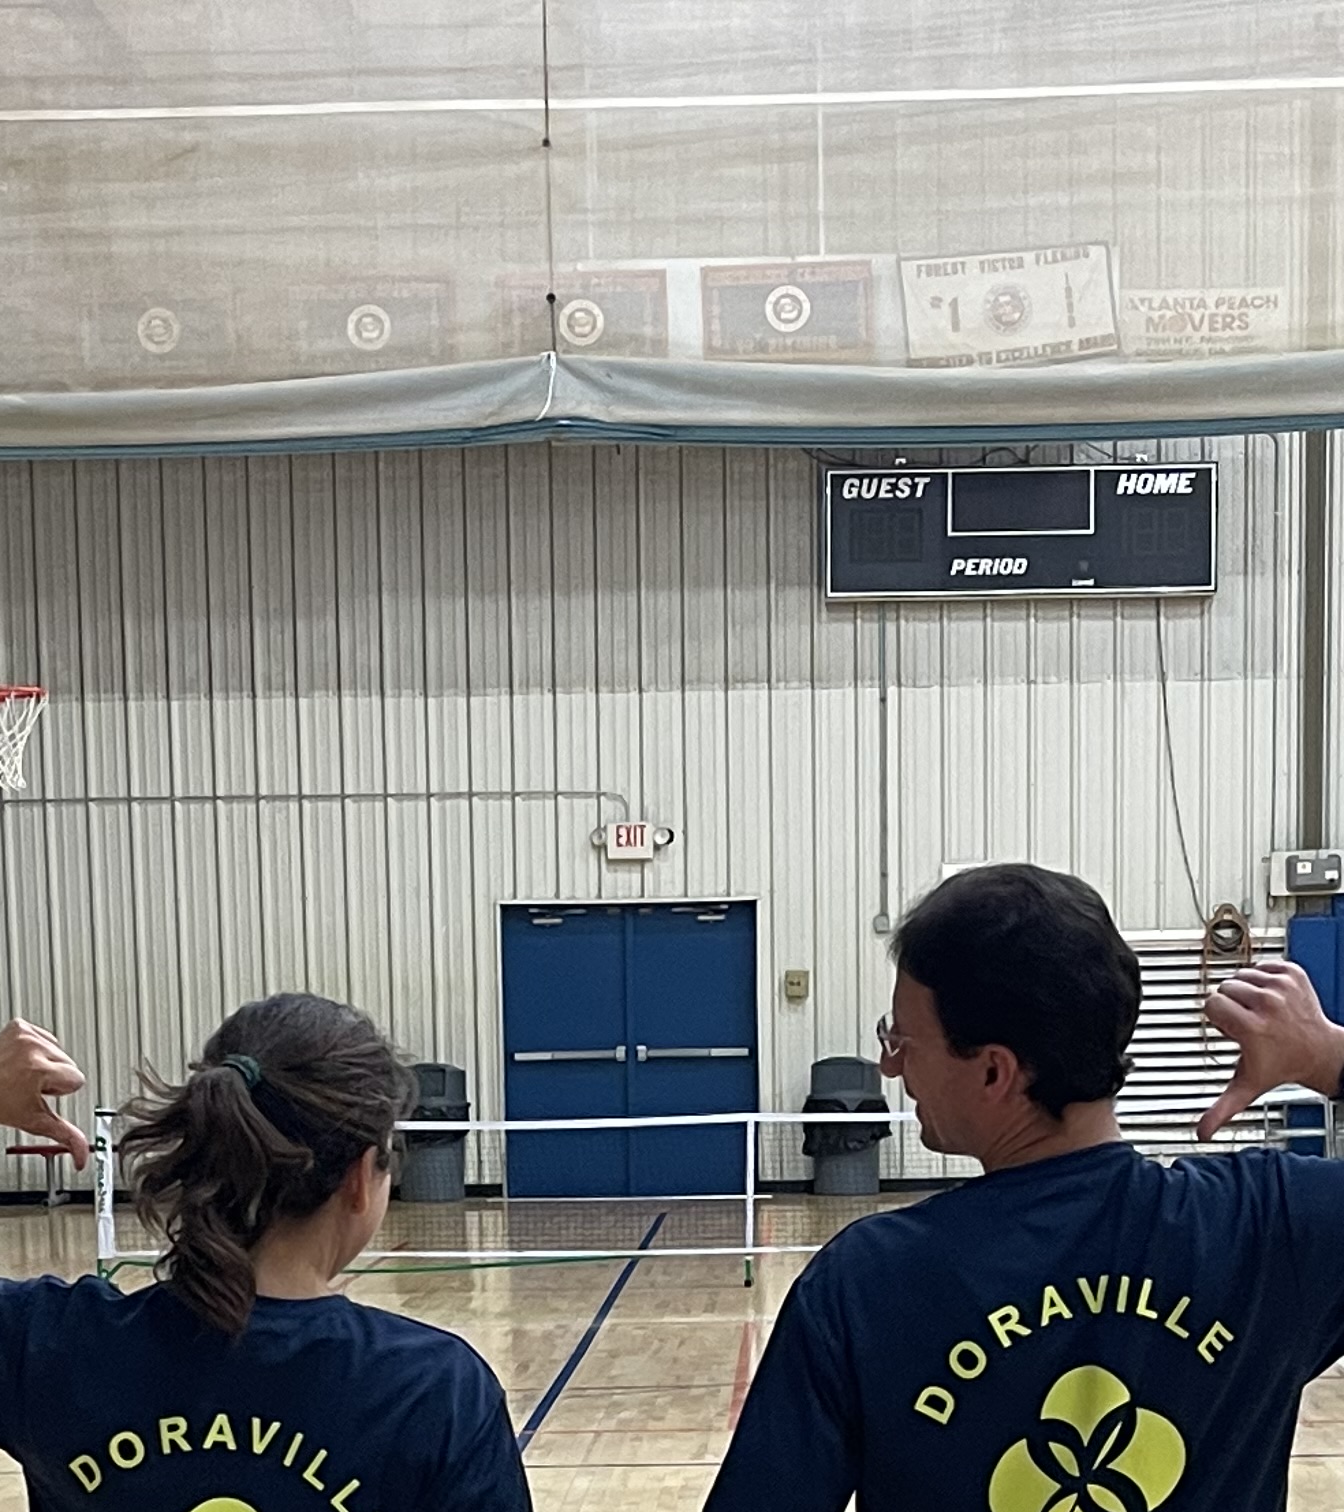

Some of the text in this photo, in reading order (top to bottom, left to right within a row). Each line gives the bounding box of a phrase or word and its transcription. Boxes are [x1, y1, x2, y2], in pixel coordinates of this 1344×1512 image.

[1215, 294, 1279, 310] PEACH
[842, 476, 931, 499] GUEST
[1115, 472, 1197, 495] HOME
[949, 557, 1028, 576] PERIOD
[616, 824, 647, 848] EXIT
[914, 1274, 1234, 1425] DORAVILLE
